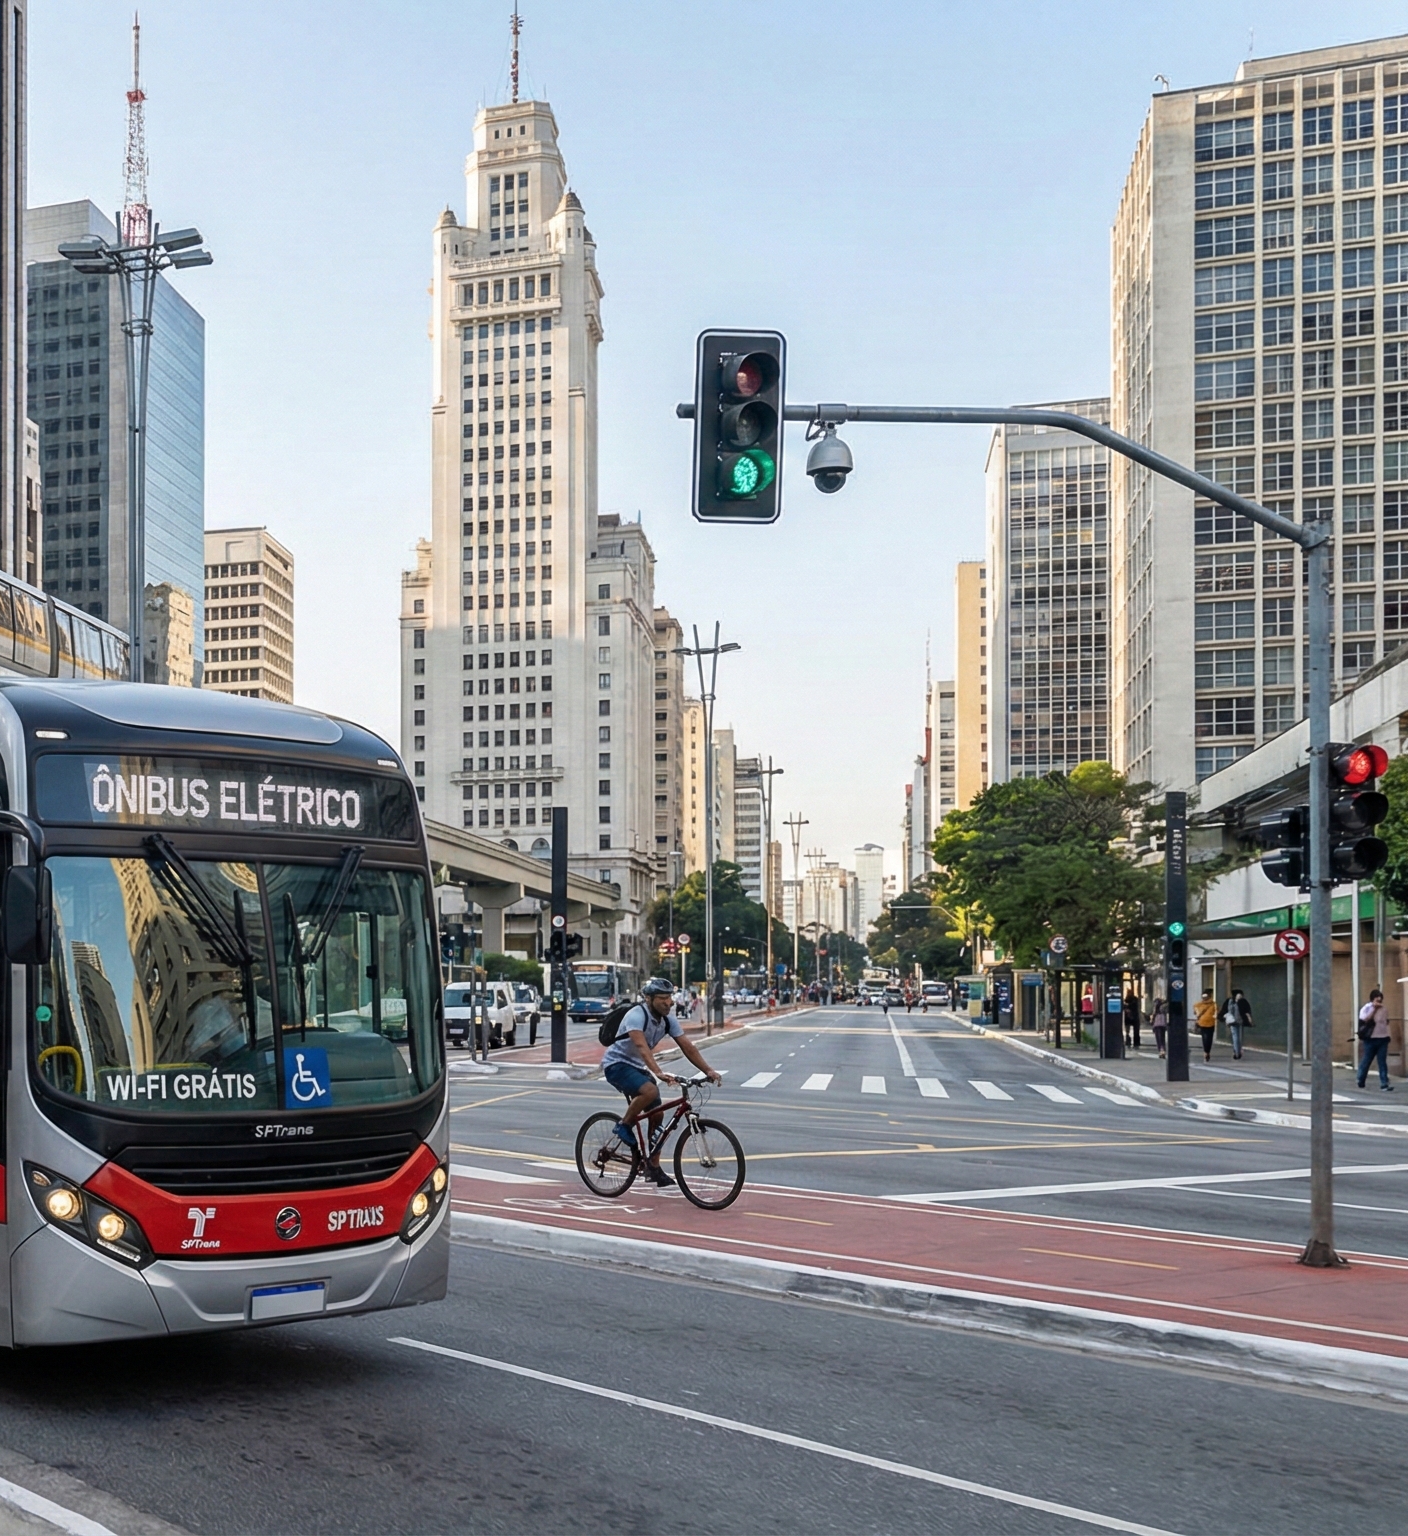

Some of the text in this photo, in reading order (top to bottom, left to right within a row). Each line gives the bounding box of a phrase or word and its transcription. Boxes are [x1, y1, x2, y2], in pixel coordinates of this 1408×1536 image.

[92, 763, 361, 829] ÔNIBUS ELÉTRICO
[107, 1067, 257, 1101] WI-FI GRÁTIS
[254, 1124, 314, 1138] SPTrans
